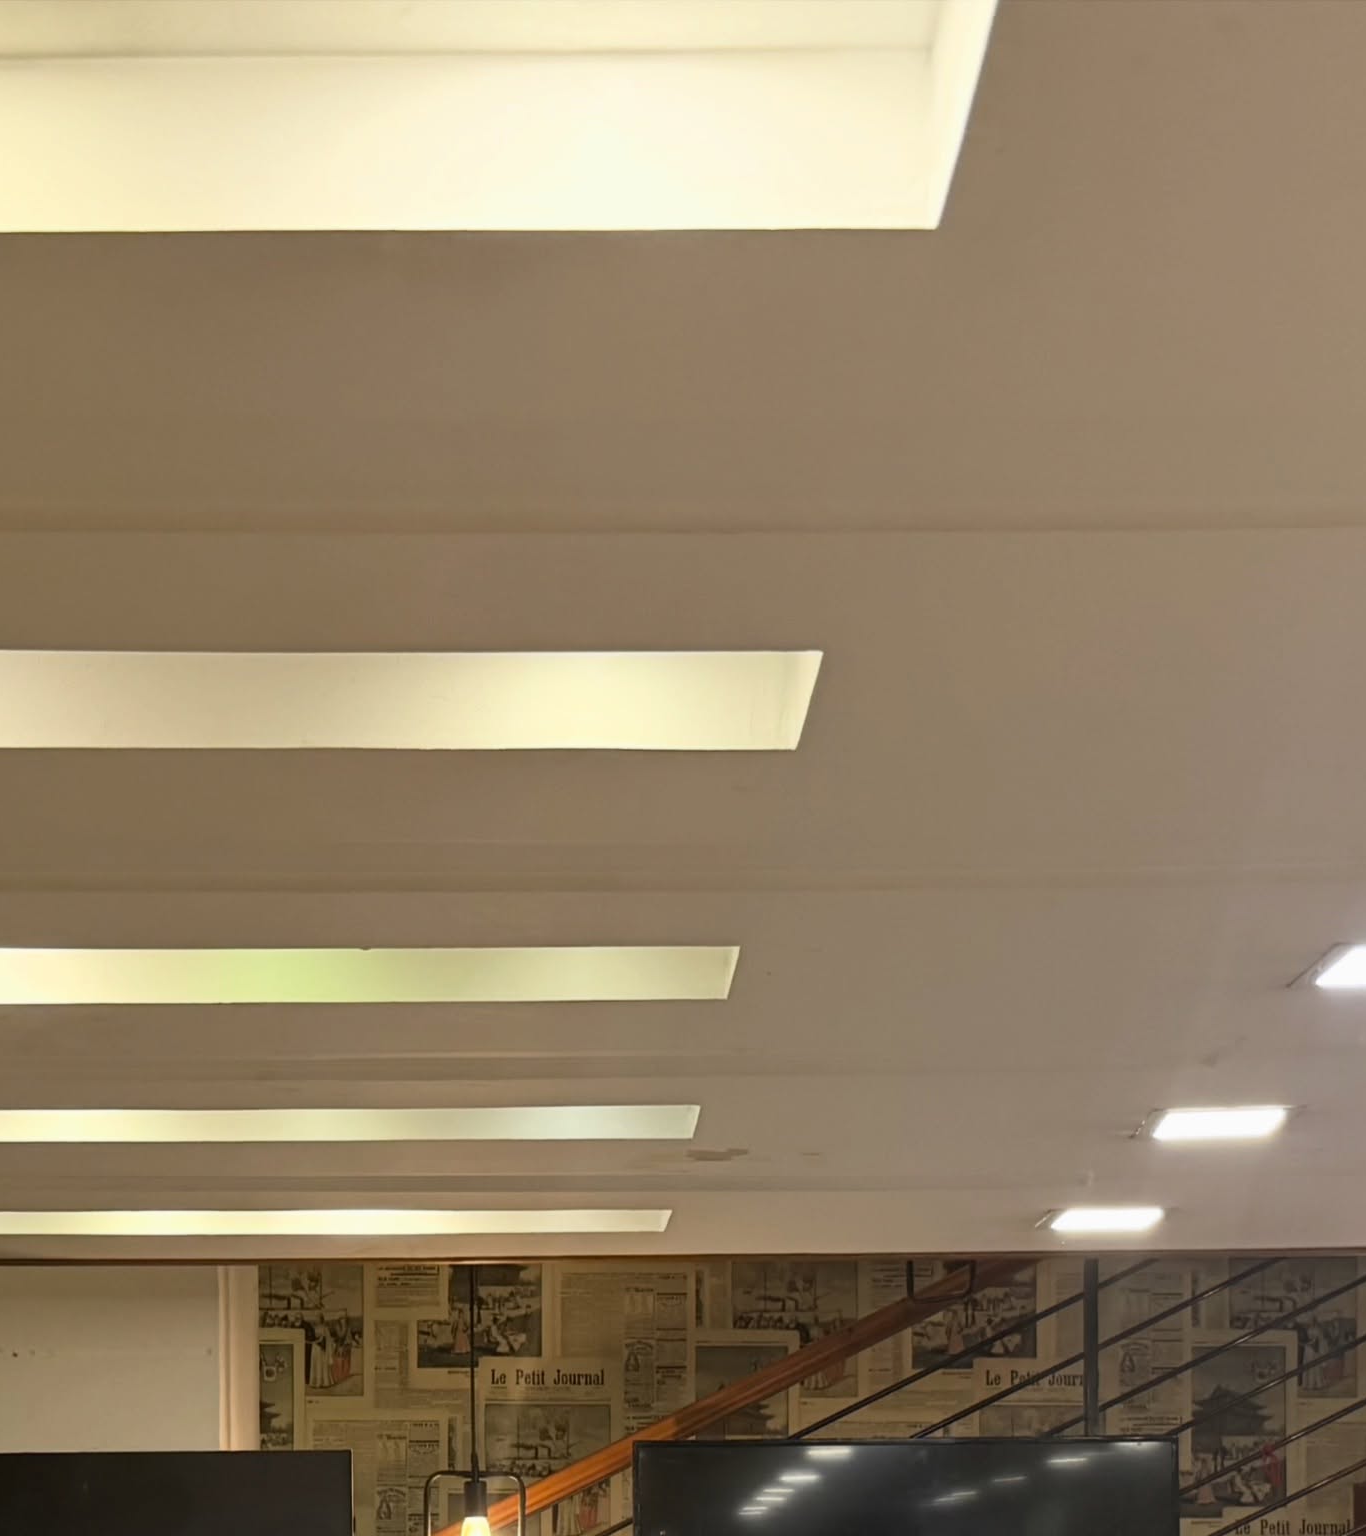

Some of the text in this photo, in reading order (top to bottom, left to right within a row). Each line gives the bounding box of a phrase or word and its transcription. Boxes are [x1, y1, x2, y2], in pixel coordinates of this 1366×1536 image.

[491, 1368, 605, 1386] Le Petit Journal
[986, 1370, 1001, 1386] Le
[1260, 1519, 1291, 1536] Petit
[1299, 1519, 1351, 1536] Journal
